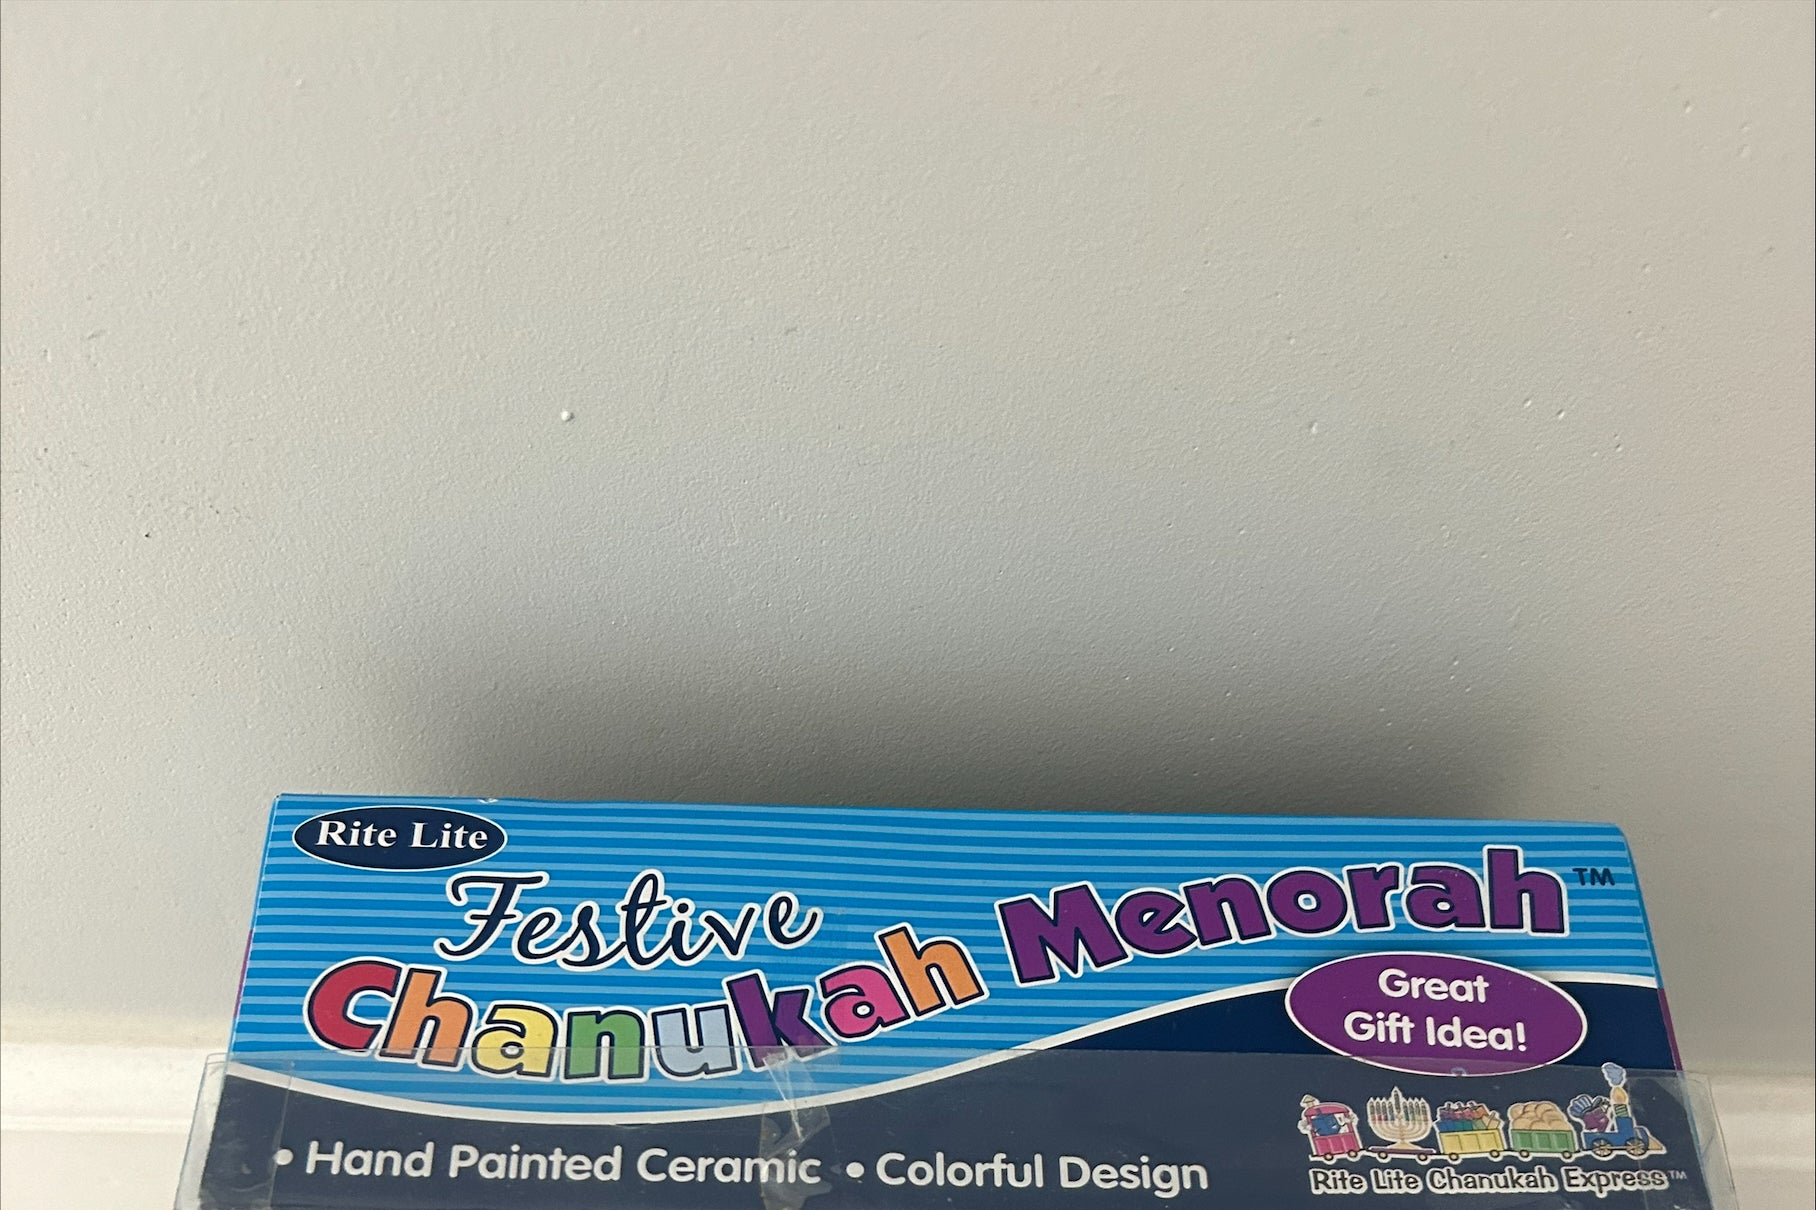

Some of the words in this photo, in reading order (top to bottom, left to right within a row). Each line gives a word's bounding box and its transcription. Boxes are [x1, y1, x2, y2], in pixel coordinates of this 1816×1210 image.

[316, 820, 397, 848] Rite
[408, 821, 488, 850] Lite
[435, 869, 824, 969] Festive
[999, 844, 1570, 986] Menorah
[305, 924, 989, 1083] Chanukah
[1378, 968, 1490, 1004] Great
[1343, 1010, 1415, 1046] Gift
[1426, 1014, 1527, 1052] Idea!
[305, 1141, 434, 1180] Hand
[448, 1141, 622, 1183] Painted
[636, 1147, 822, 1185] Ceramic
[876, 1152, 1044, 1190] Colorful
[1059, 1156, 1209, 1198] Design
[1310, 1168, 1368, 1194] Rite
[1371, 1169, 1424, 1194] Lite
[1426, 1166, 1558, 1194] Chanukah
[1563, 1168, 1668, 1199] Express
